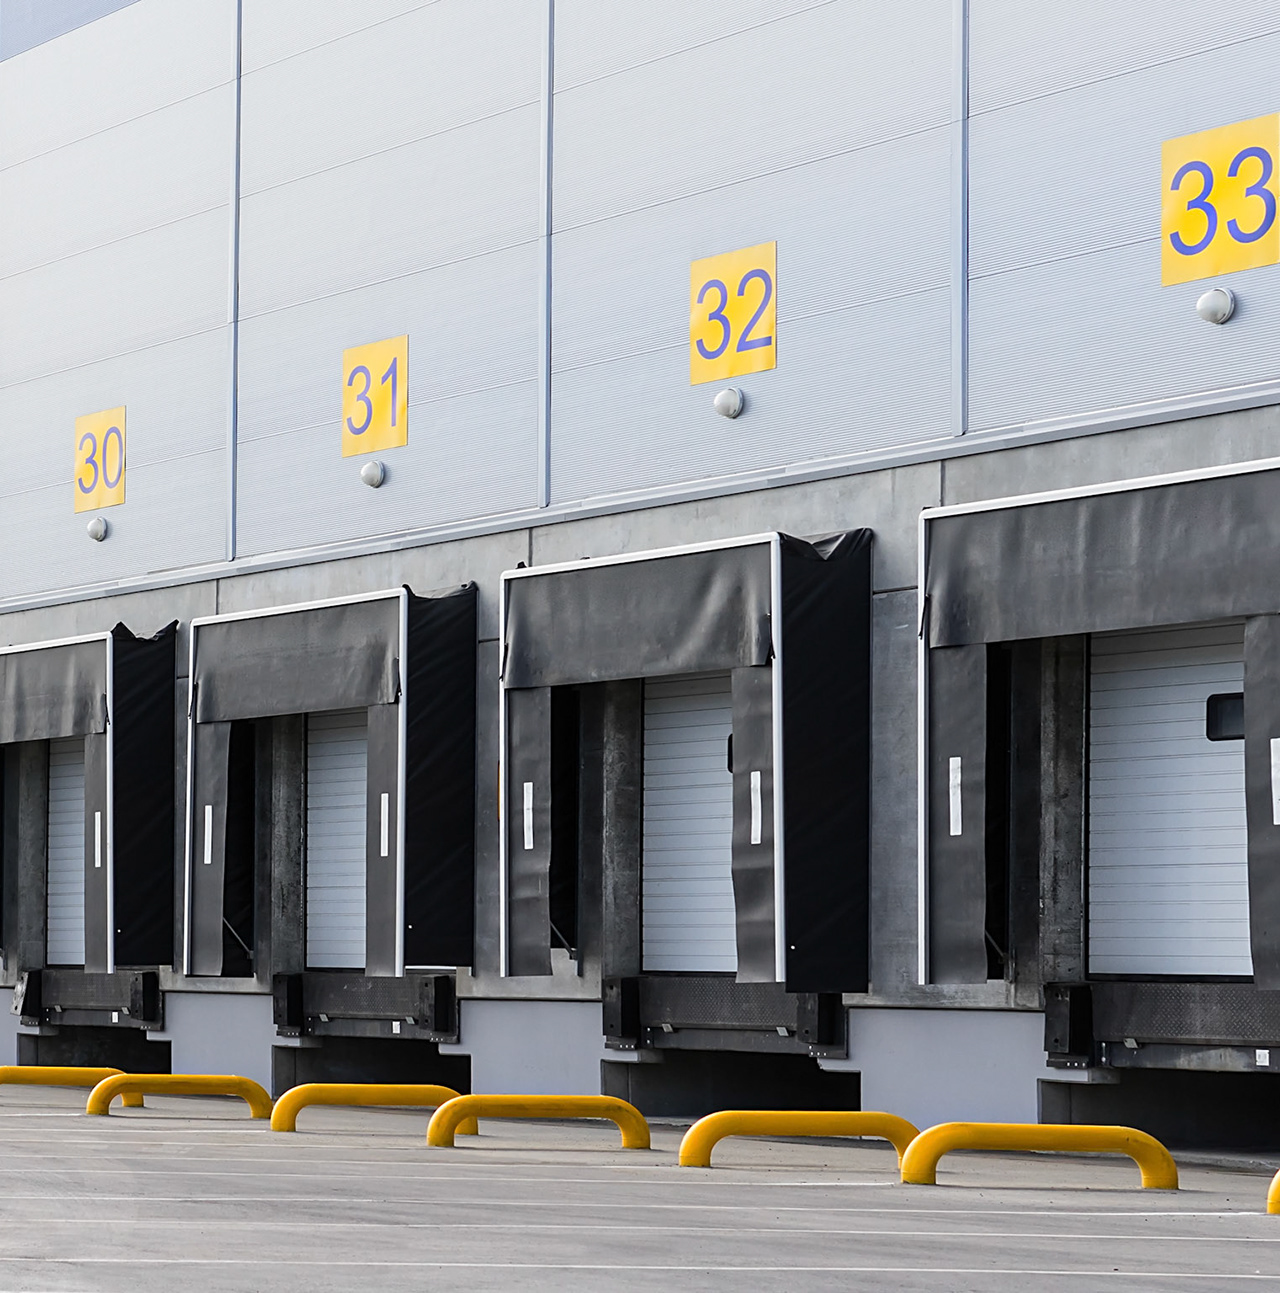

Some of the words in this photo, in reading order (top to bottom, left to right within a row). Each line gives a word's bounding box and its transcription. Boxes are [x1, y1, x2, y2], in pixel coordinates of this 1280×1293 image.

[1170, 147, 1276, 255] 33
[696, 269, 772, 359] 32
[347, 358, 397, 435] 31
[78, 427, 123, 494] 30
